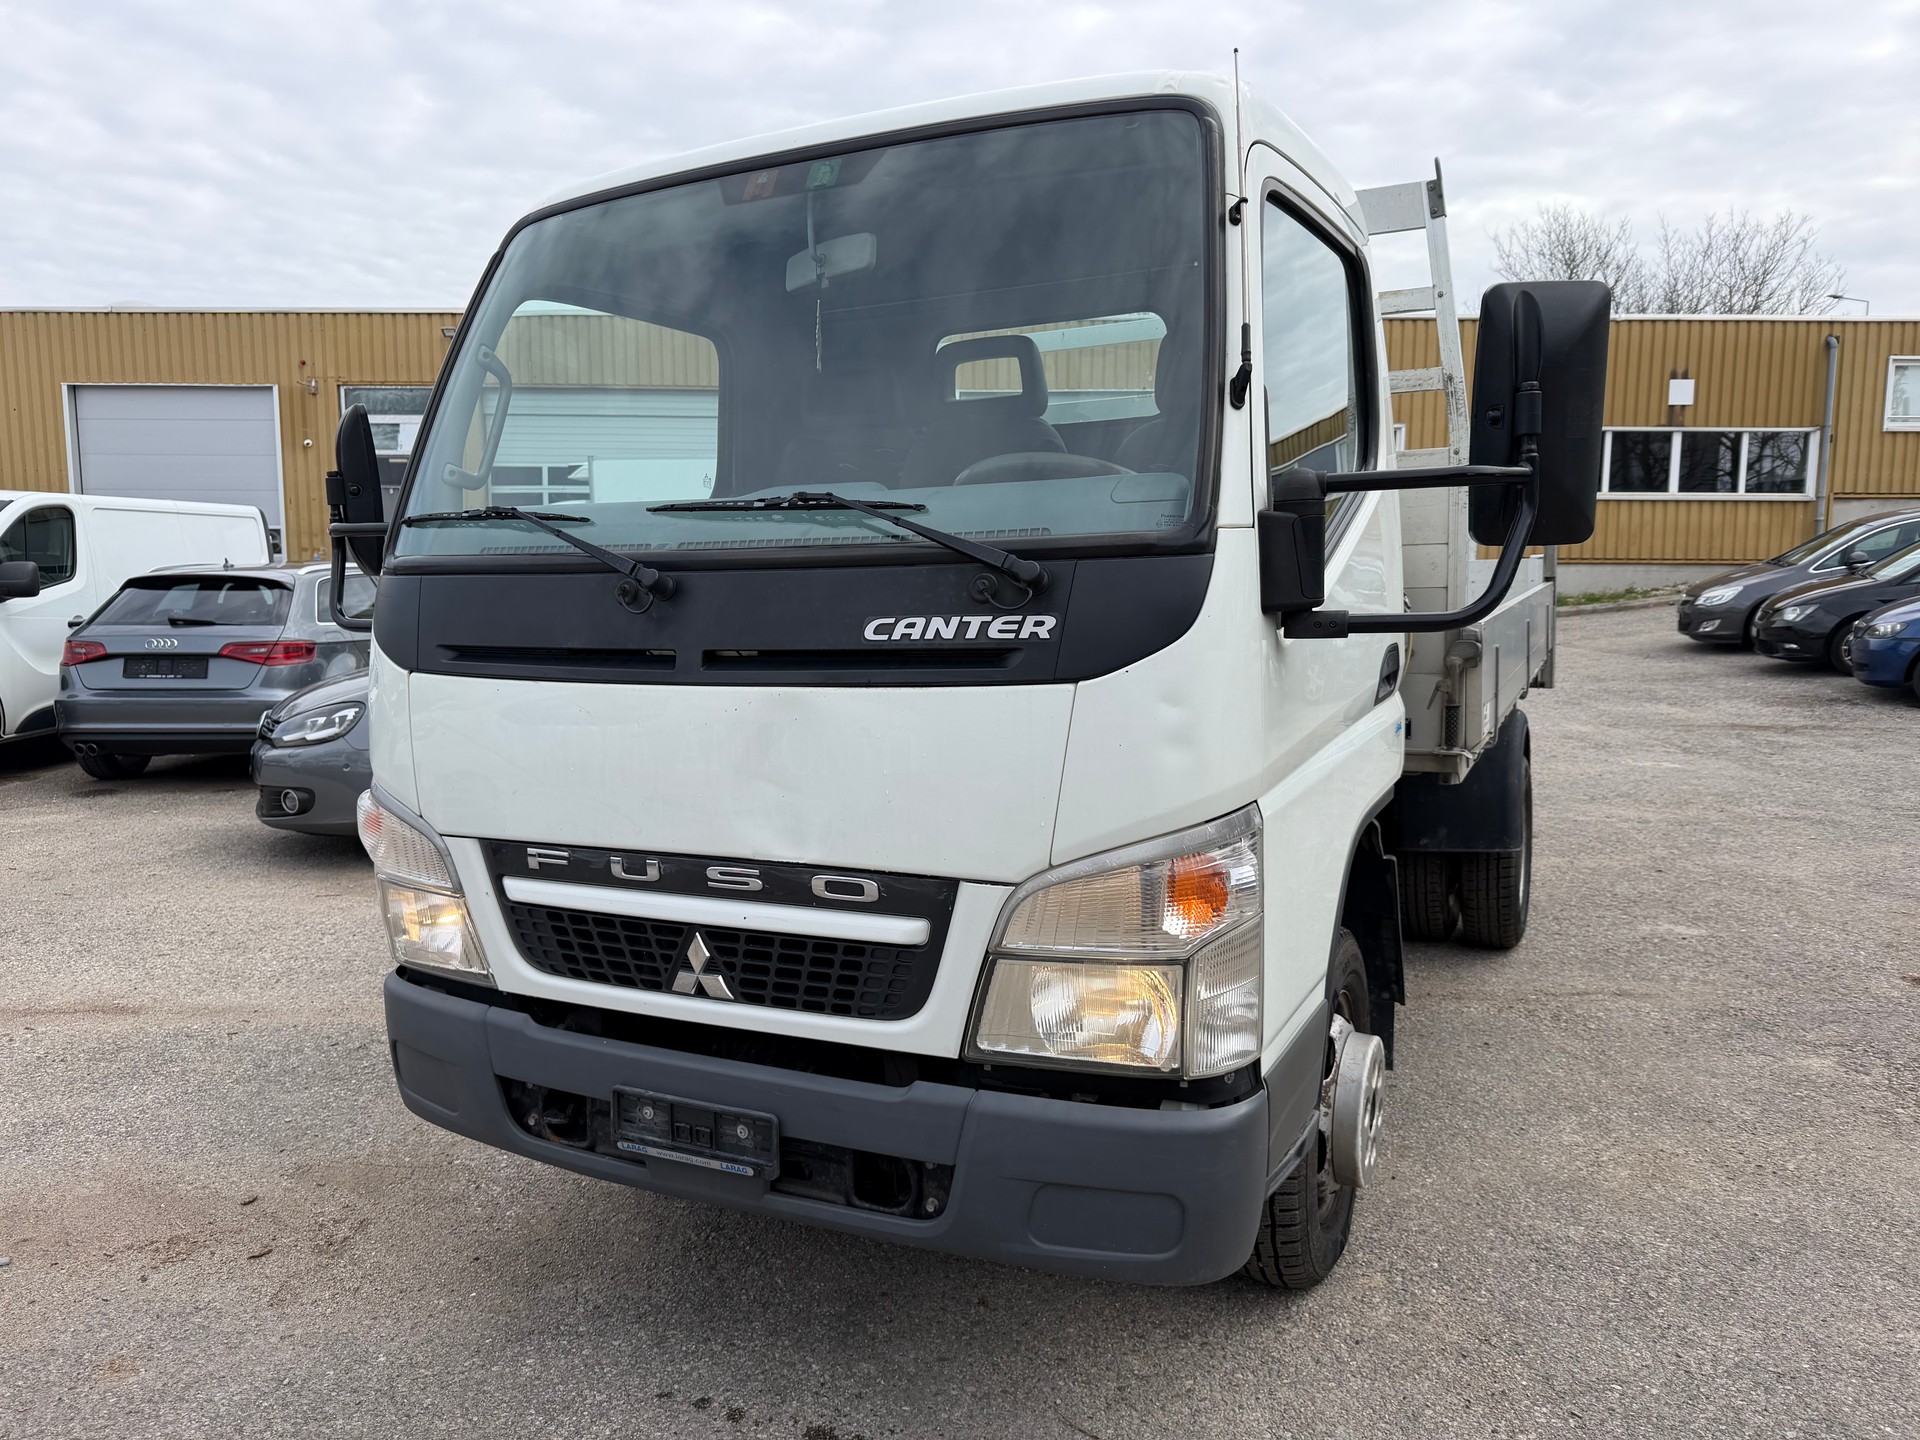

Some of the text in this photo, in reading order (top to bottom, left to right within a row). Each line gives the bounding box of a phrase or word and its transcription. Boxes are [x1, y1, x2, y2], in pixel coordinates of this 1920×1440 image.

[863, 615, 1057, 641] CANTER
[526, 847, 880, 903] FUSO
[621, 1142, 648, 1153] LARAG
[720, 1162, 748, 1174] LARAG
